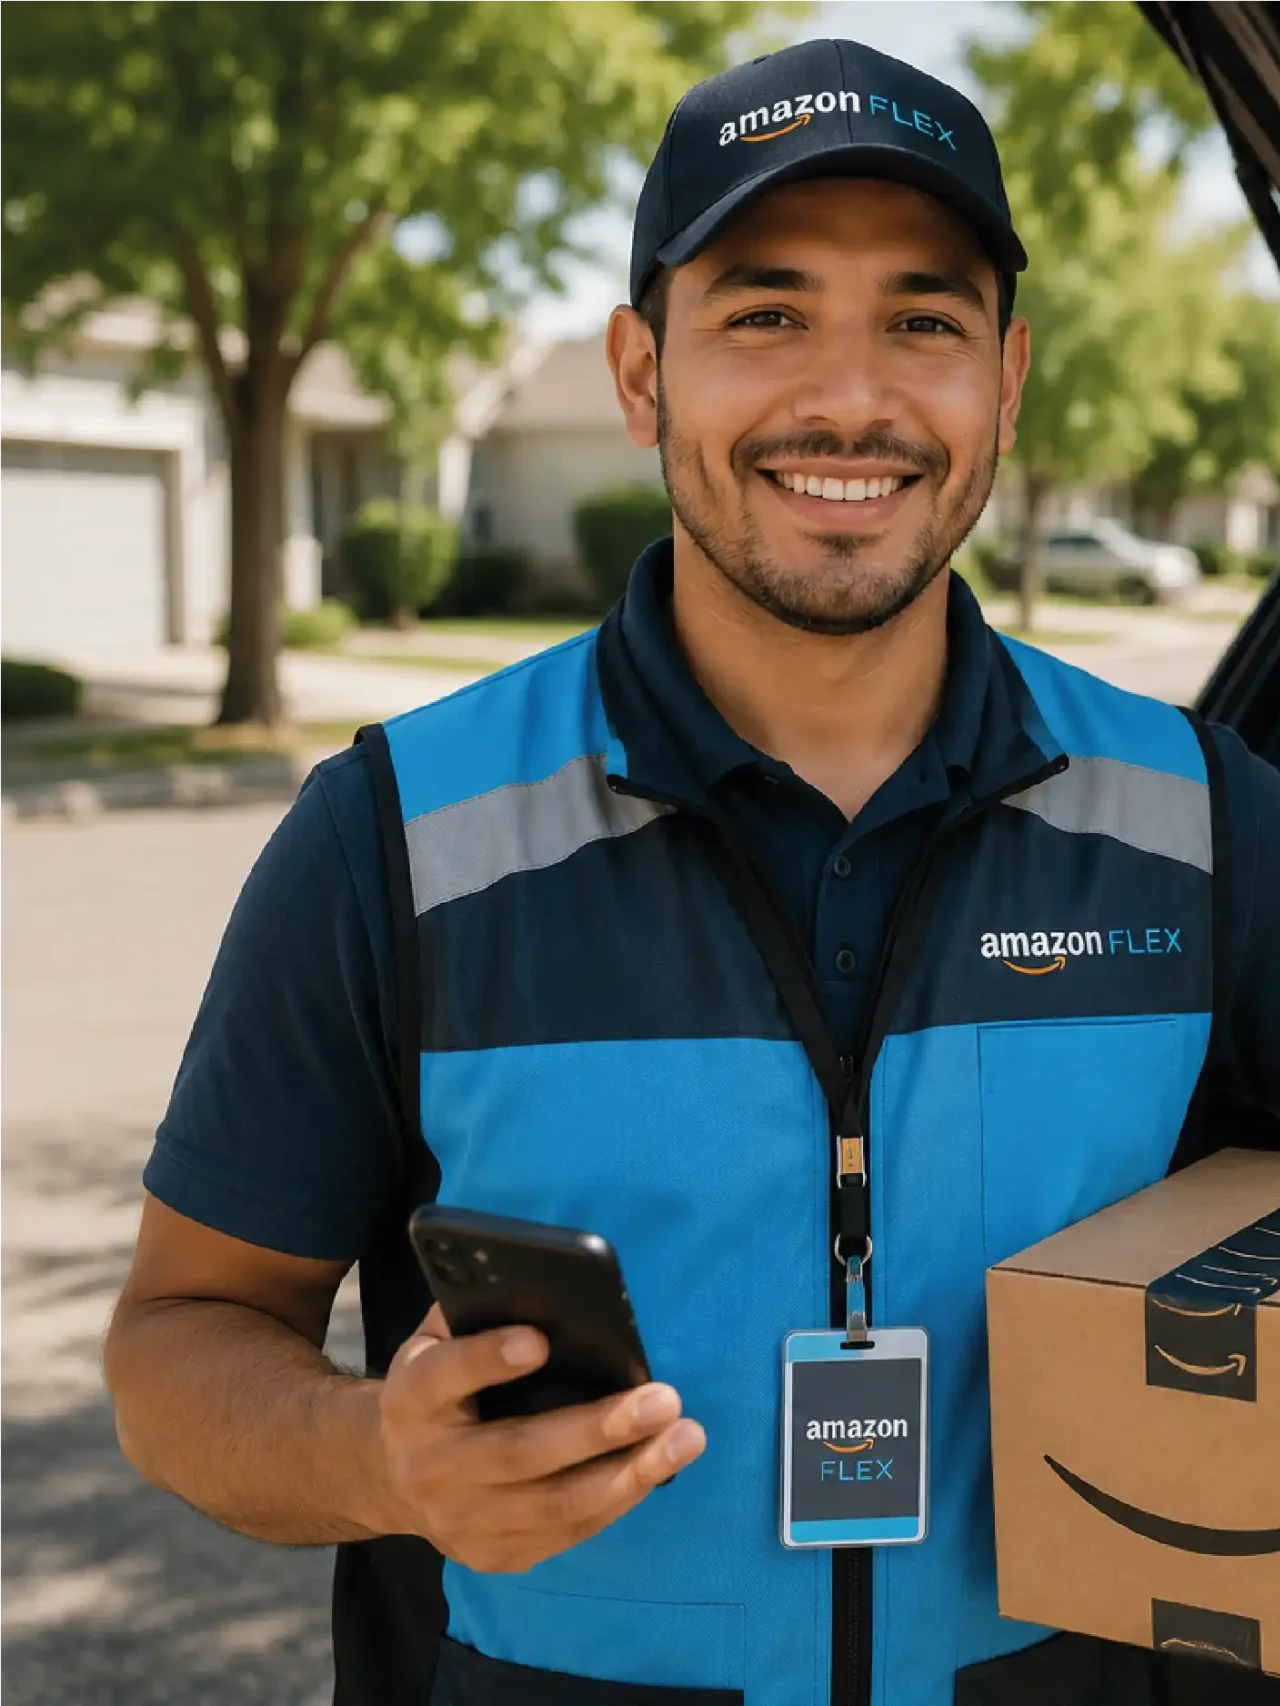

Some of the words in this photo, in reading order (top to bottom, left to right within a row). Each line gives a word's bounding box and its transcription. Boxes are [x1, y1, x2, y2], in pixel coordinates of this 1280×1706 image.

[719, 90, 861, 146] amazon
[869, 94, 956, 150] FLEX
[980, 929, 1103, 959] amazon
[1108, 927, 1182, 955] FLEX
[806, 1418, 908, 1440] amazon
[821, 1459, 893, 1481] FLEX
